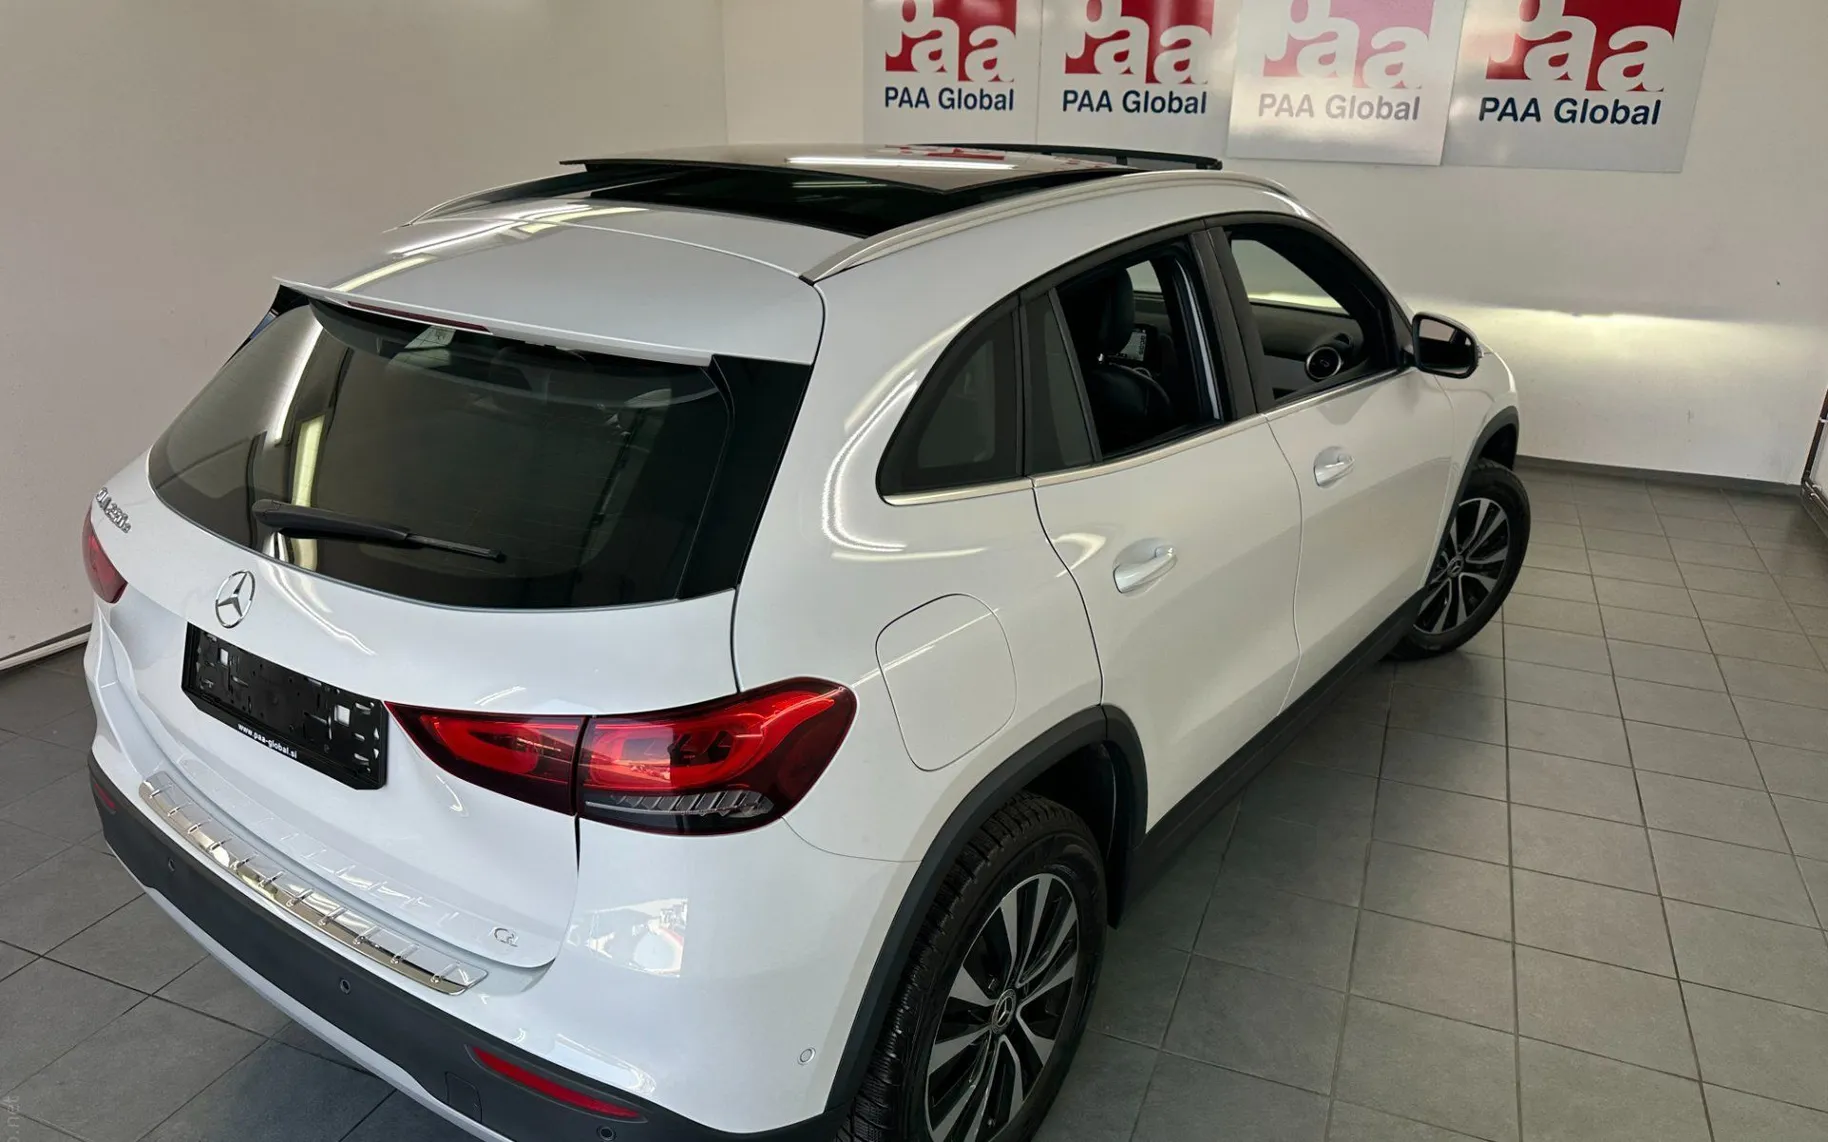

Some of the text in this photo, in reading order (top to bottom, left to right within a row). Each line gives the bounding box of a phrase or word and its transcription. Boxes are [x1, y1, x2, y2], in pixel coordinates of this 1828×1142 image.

[884, 86, 1015, 111] PAA Global
[1062, 90, 1208, 115] PAA Global
[1257, 93, 1421, 121] PAA Global
[1478, 97, 1662, 126] PAA Global
[237, 723, 298, 759] www.paa-global.si
